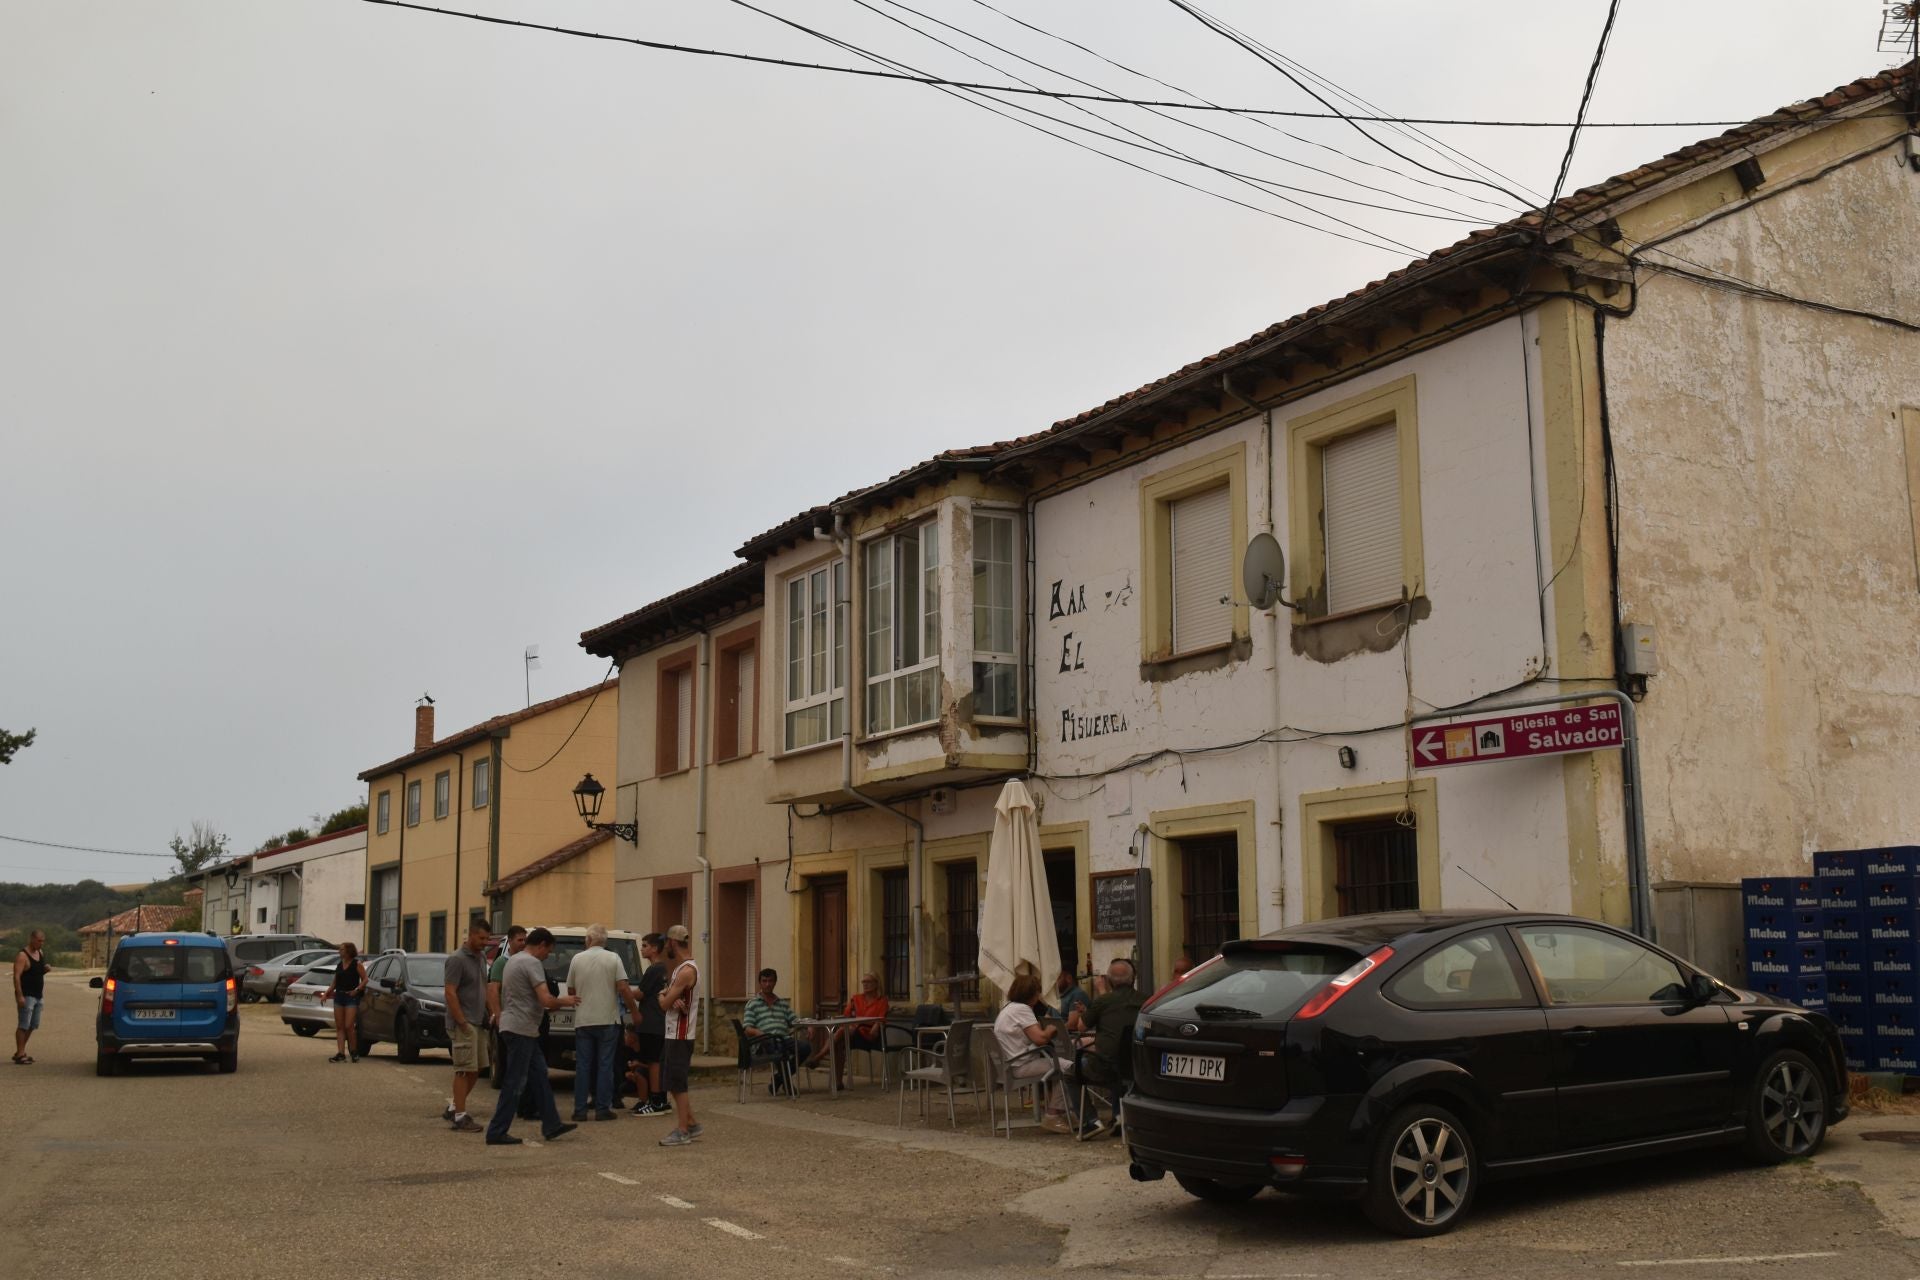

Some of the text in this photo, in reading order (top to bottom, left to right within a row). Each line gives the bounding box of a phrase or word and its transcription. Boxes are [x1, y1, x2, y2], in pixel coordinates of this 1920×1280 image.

[1049, 579, 1087, 621] BAR
[1059, 632, 1084, 674] EL
[1564, 713, 1581, 724] de
[1589, 709, 1617, 721] San
[1528, 726, 1619, 749] Salvador
[1819, 867, 1855, 877] Mahou
[1867, 863, 1906, 874] Mahou
[1747, 895, 1784, 906] Mahou
[1821, 898, 1857, 908] Mahou
[1869, 896, 1907, 906] Mahou
[1749, 927, 1787, 939] Mahou
[1823, 929, 1859, 940] Mahou
[1871, 928, 1909, 939] Mahou
[1751, 961, 1789, 973] Mahou
[1873, 960, 1911, 971] Mahou
[1875, 993, 1913, 1004] Mahou
[1838, 1024, 1863, 1035] ahou
[1877, 1025, 1915, 1036] Mahou
[1167, 1056, 1222, 1078] 6171 DPK
[1879, 1057, 1917, 1068] Mahou
